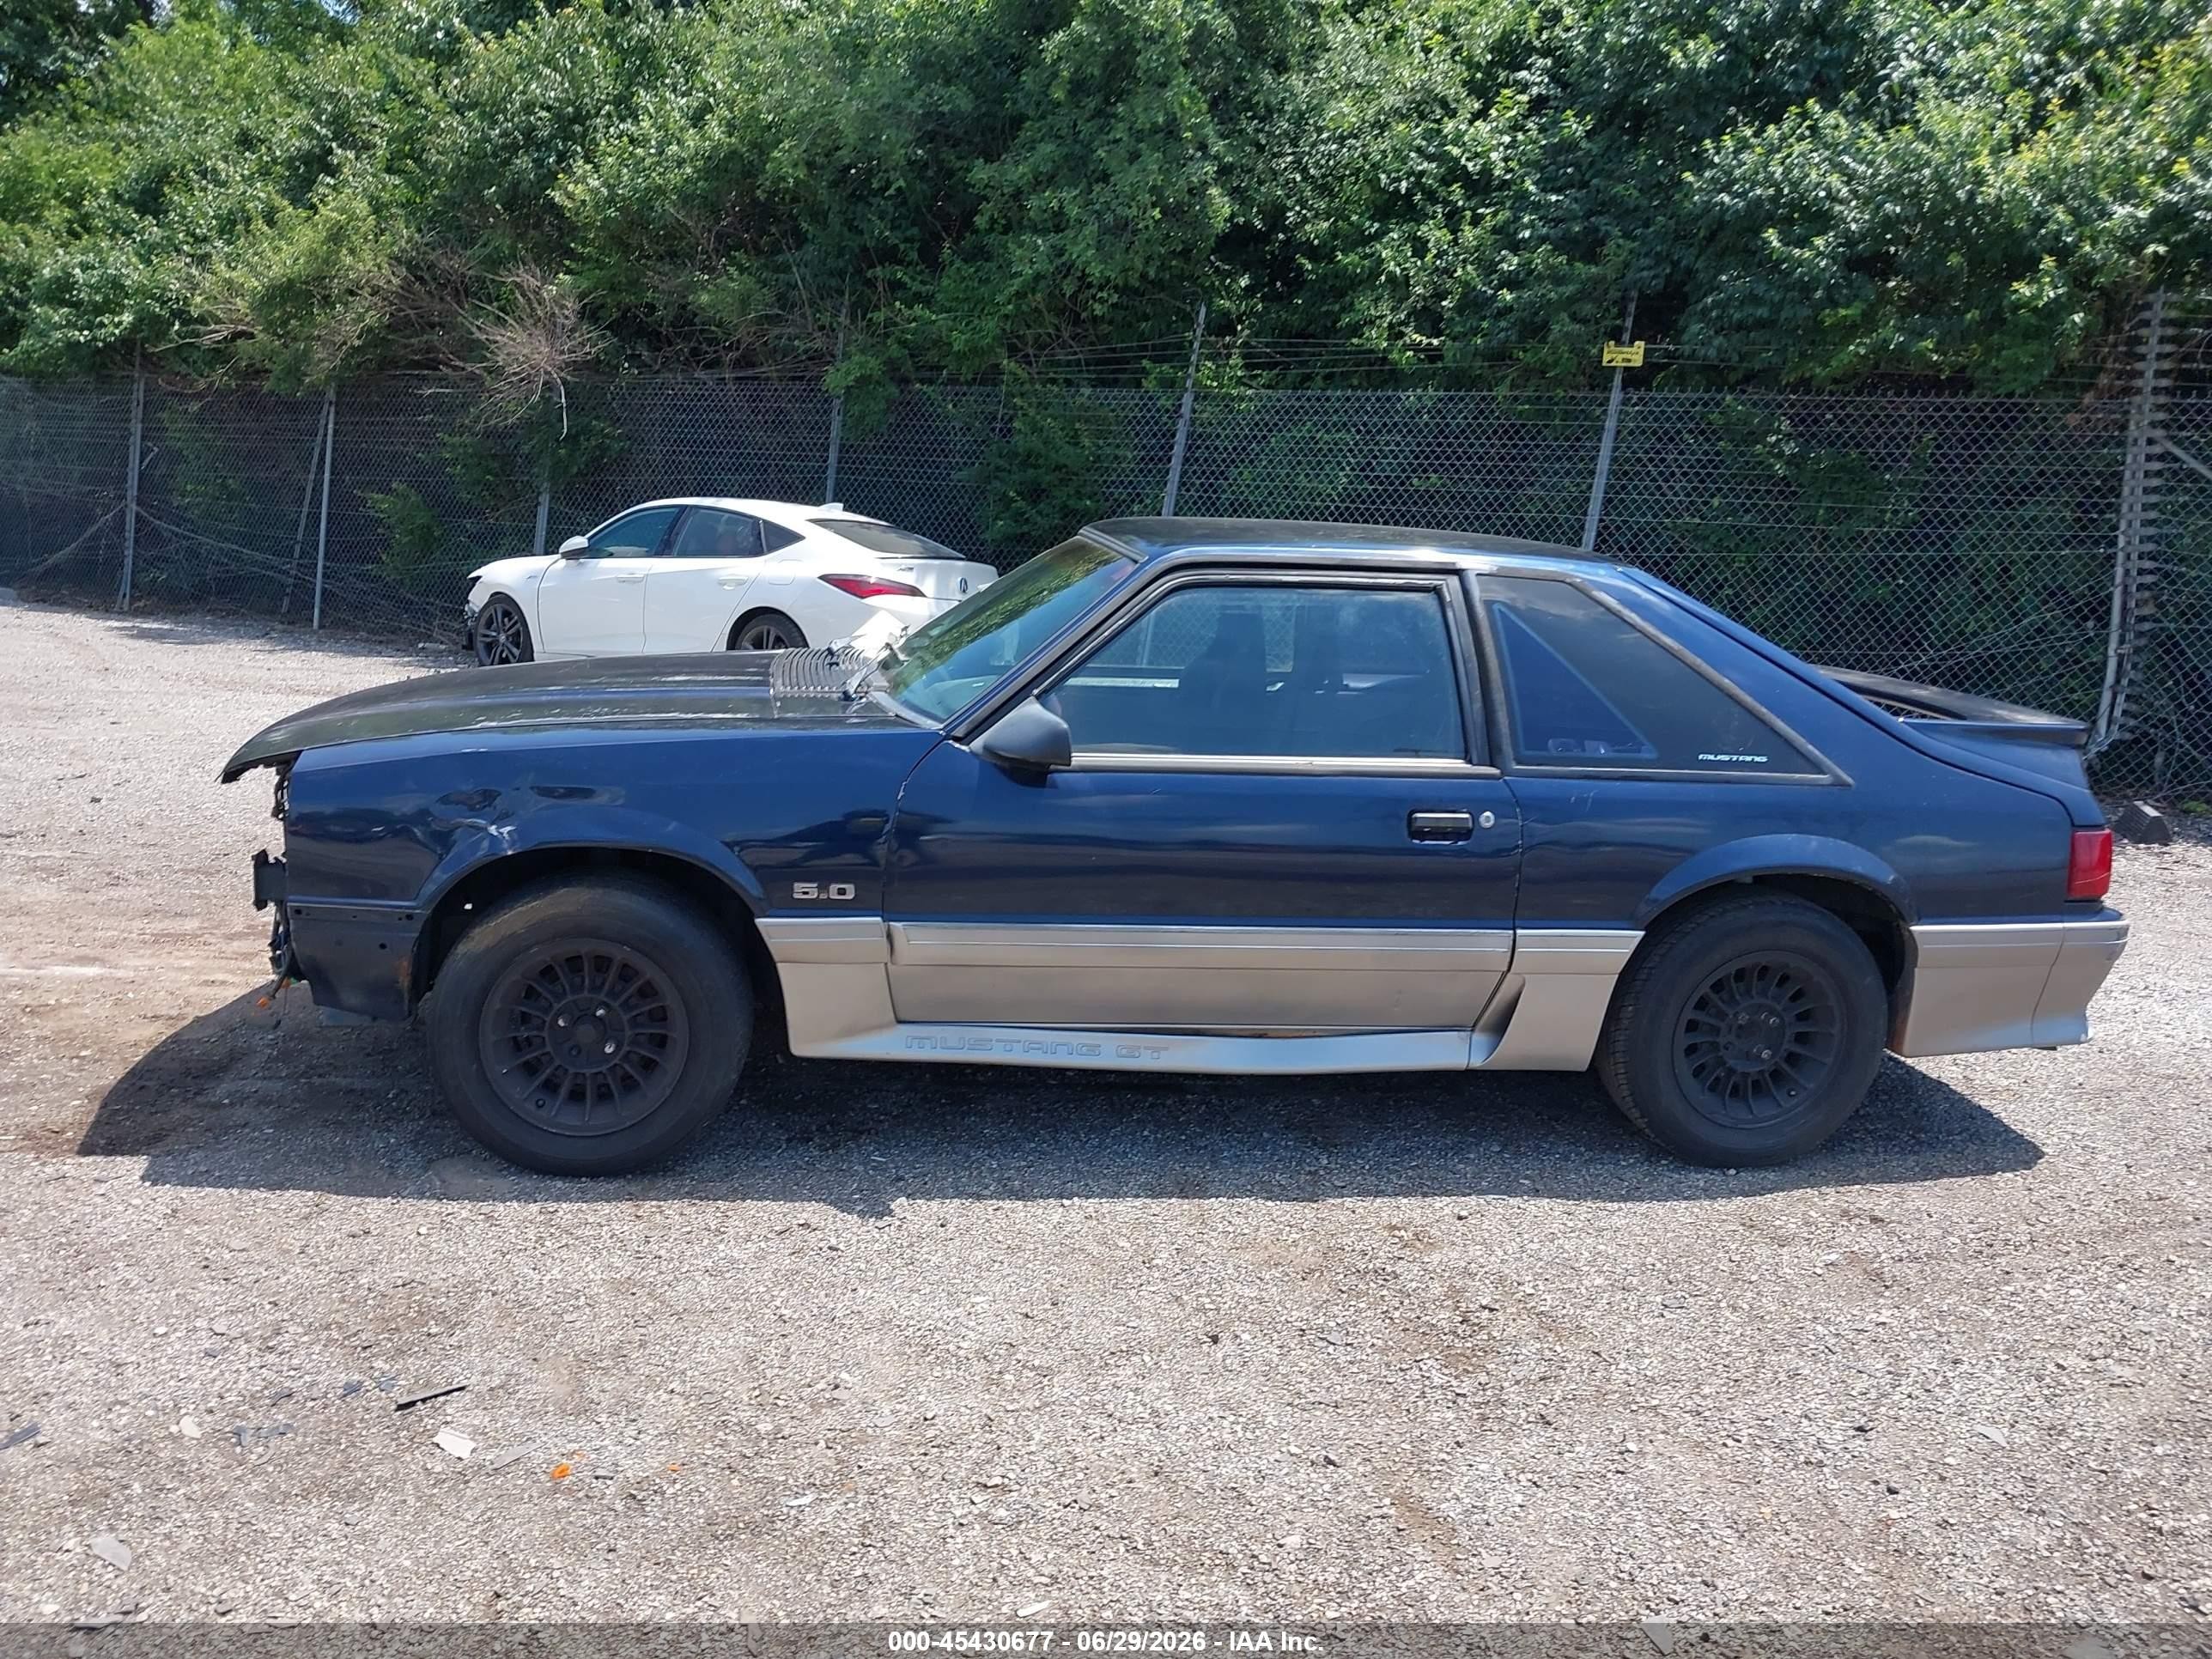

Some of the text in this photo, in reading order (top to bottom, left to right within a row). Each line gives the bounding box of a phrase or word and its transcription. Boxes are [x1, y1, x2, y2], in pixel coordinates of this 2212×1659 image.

[1698, 754, 1769, 763] MUSTANG
[792, 882, 856, 900] 5.0
[904, 1036, 1170, 1060] MUSTANG GT
